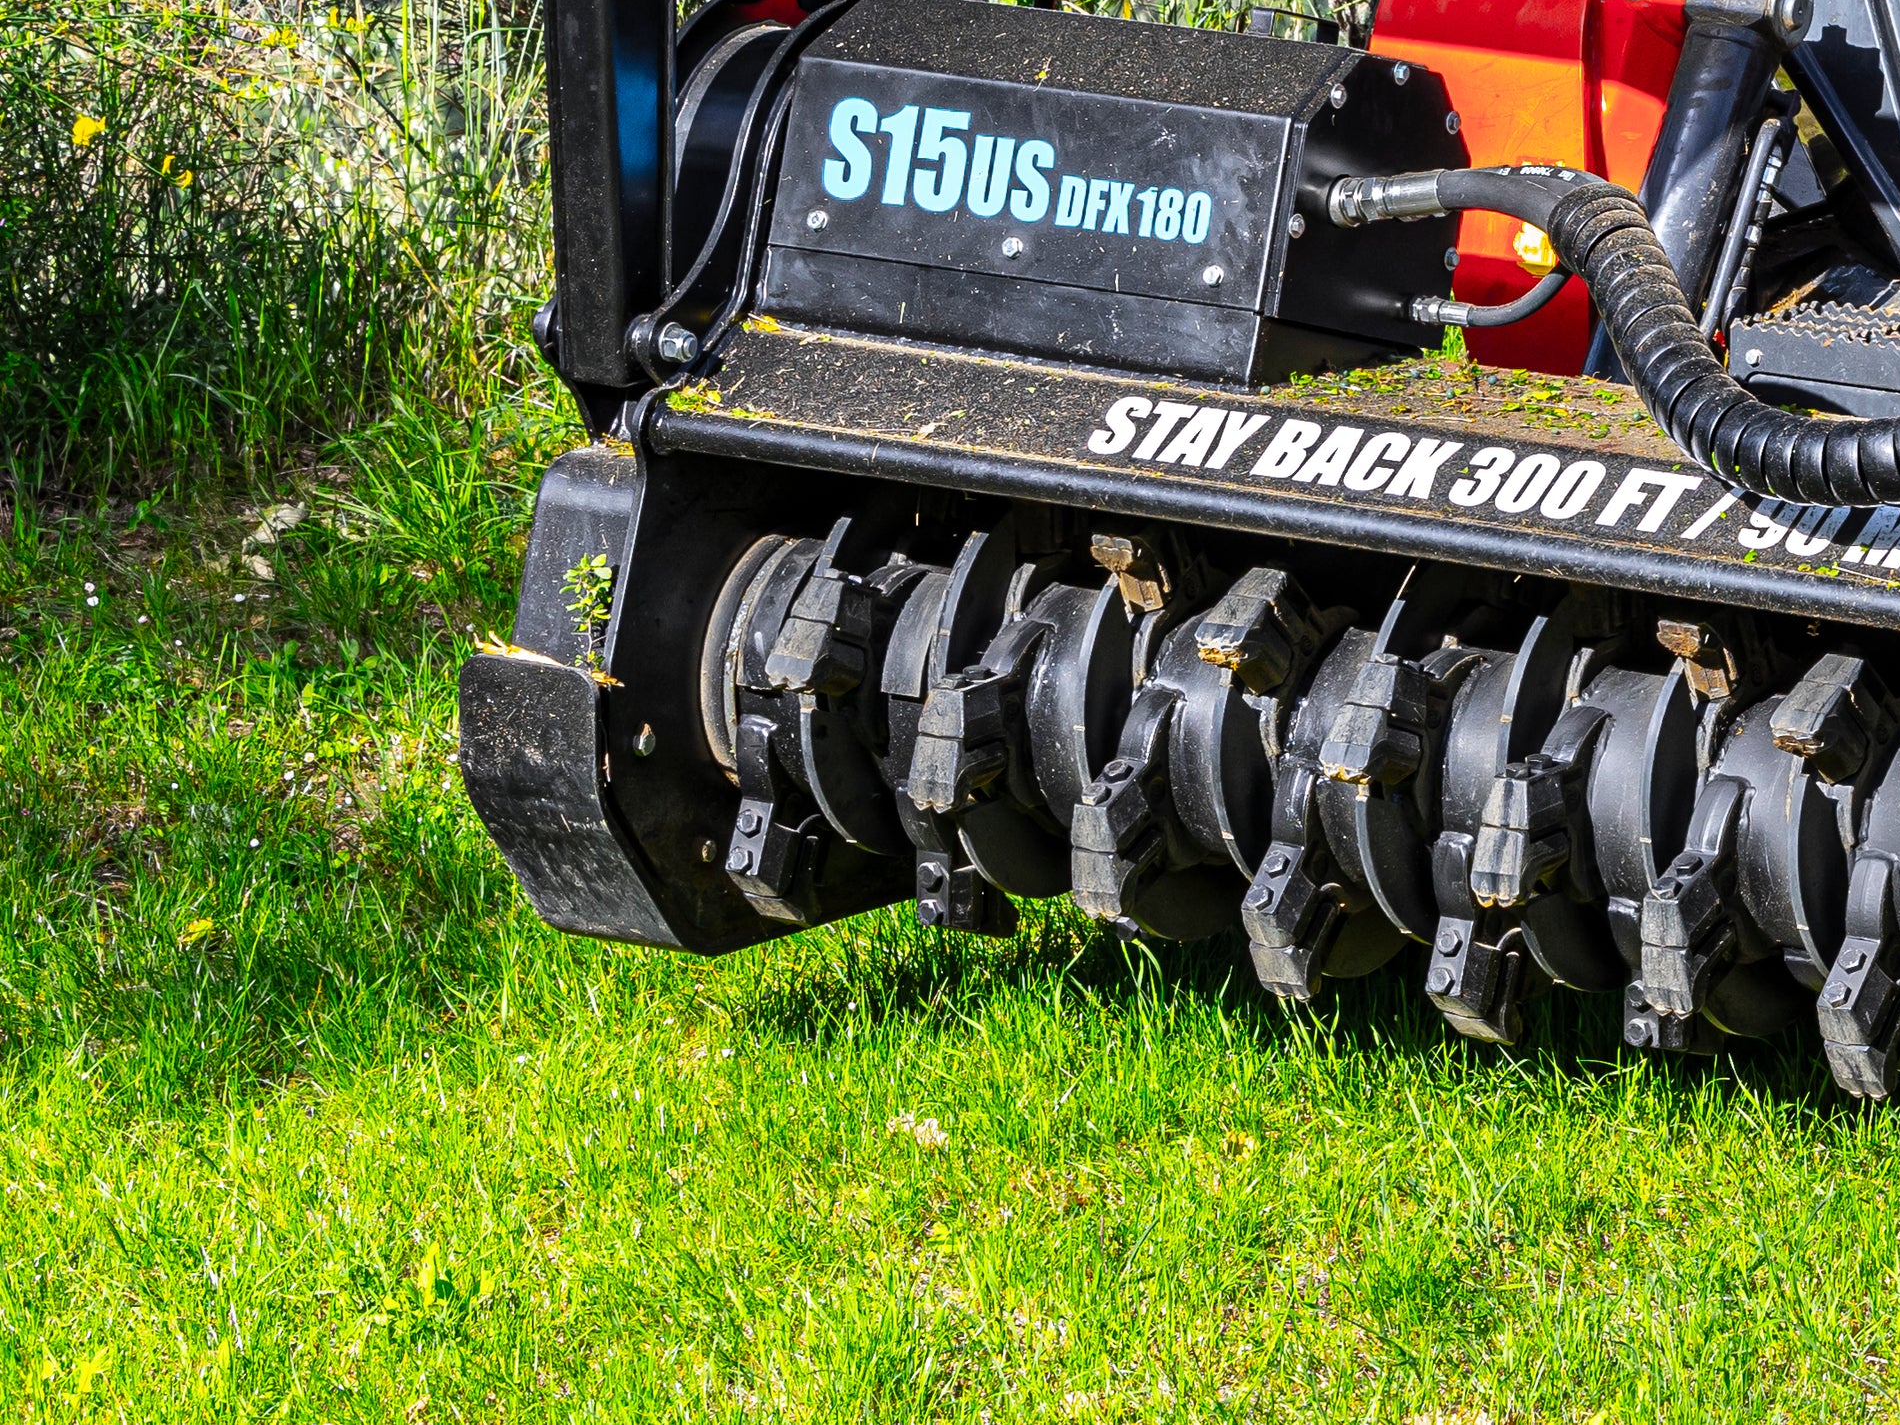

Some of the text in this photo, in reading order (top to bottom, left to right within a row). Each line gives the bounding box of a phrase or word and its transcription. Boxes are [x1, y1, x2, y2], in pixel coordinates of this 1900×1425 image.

[1087, 396, 1271, 470] STAY
[1251, 419, 1462, 498] BACK
[1453, 447, 1606, 519] 300
[1597, 467, 1704, 532] FT
[1738, 496, 1851, 556] 90
